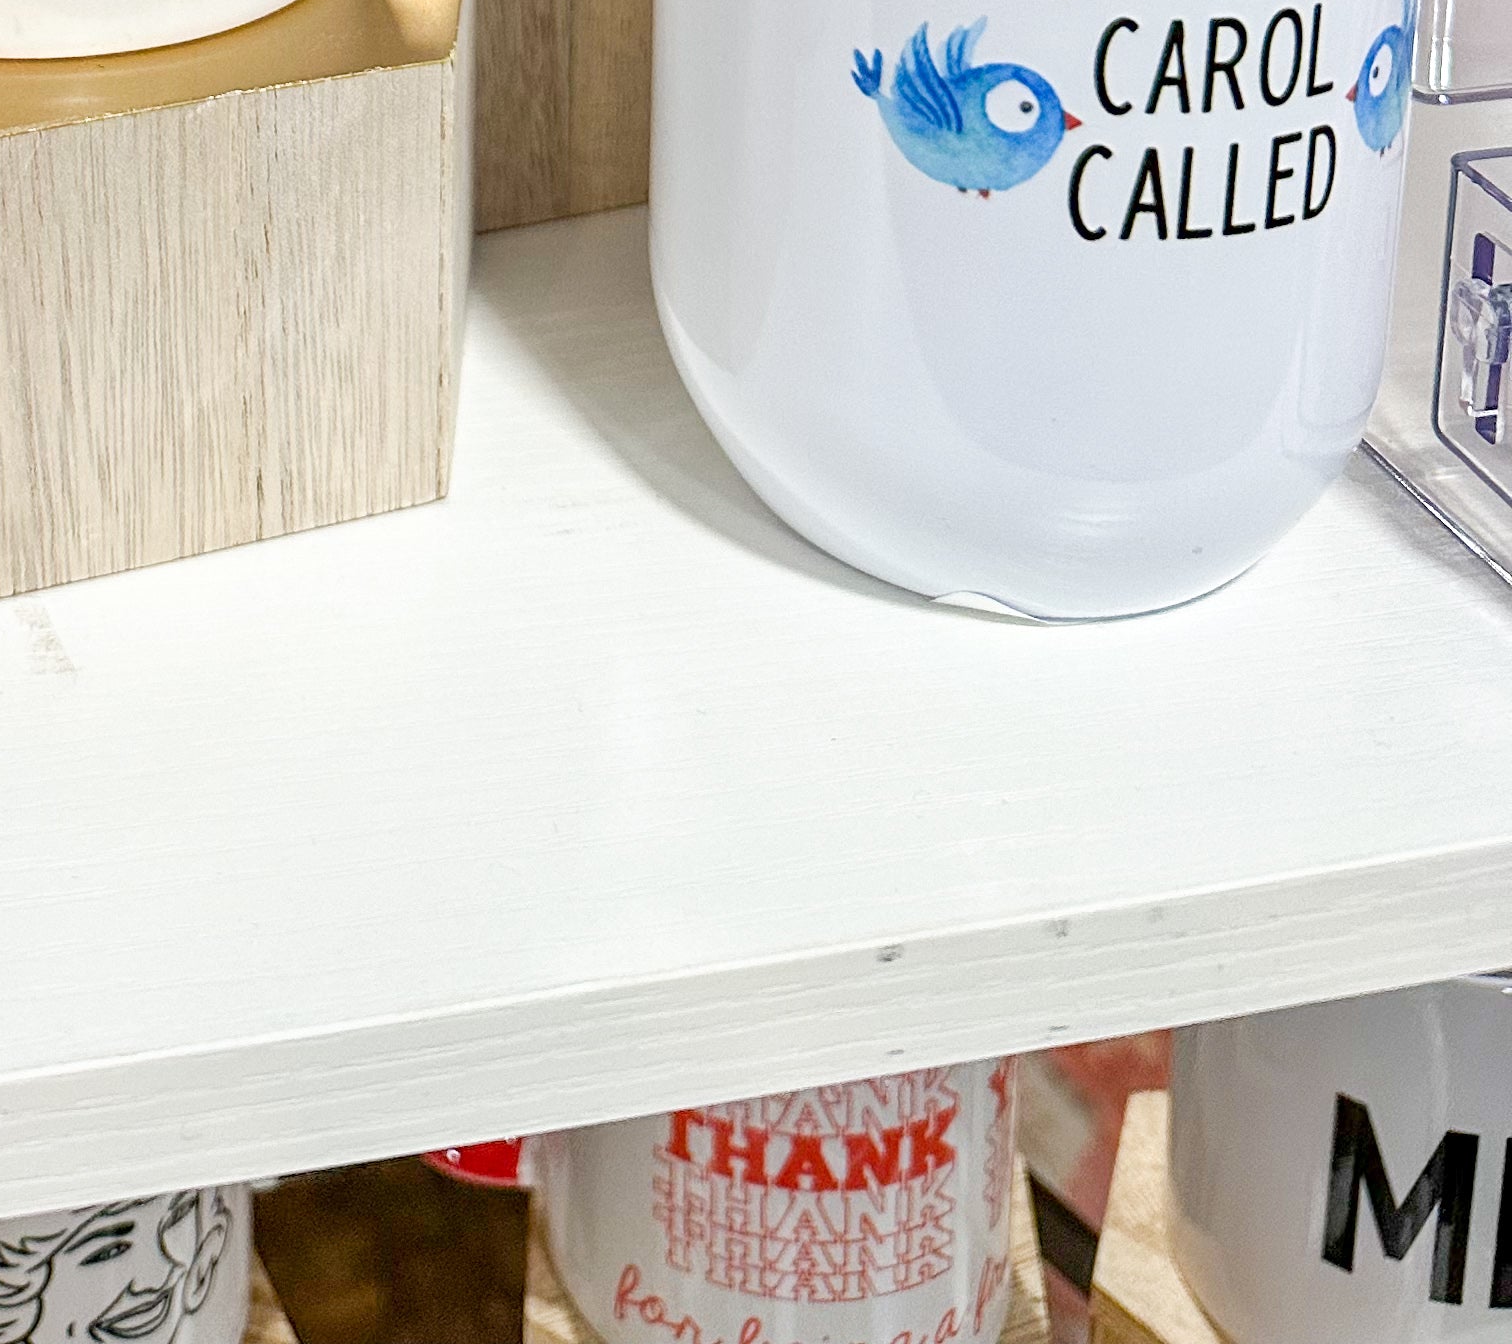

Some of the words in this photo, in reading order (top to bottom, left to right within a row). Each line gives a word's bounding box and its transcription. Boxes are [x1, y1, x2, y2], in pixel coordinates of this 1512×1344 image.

[1093, 2, 1334, 116] CAROL
[1067, 124, 1337, 241] CALLED
[666, 1107, 960, 1192] THANK
